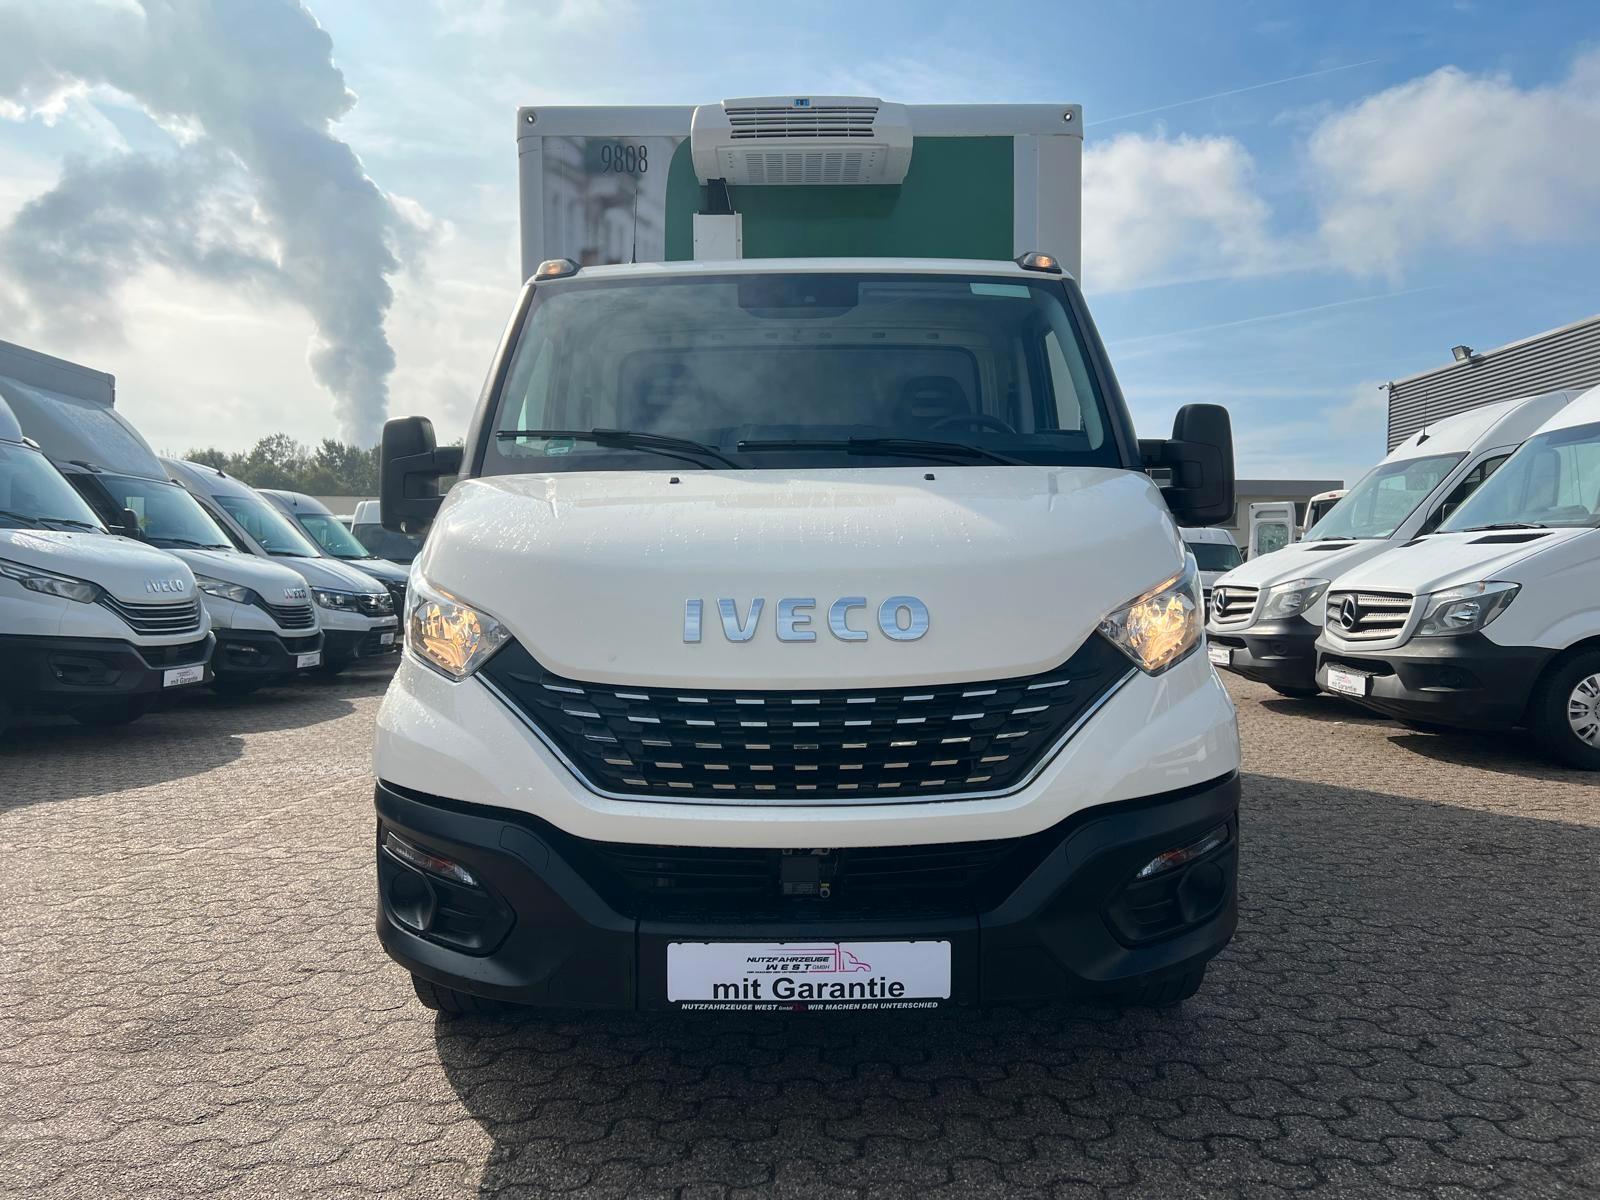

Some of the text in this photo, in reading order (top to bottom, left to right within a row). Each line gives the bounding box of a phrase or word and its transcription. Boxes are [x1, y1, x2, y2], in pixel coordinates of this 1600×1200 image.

[601, 145, 648, 173] 9808
[683, 595, 930, 643] IVECO
[713, 976, 905, 1000] mit Garantie
[880, 1001, 938, 1009] UNTERSCHIED
